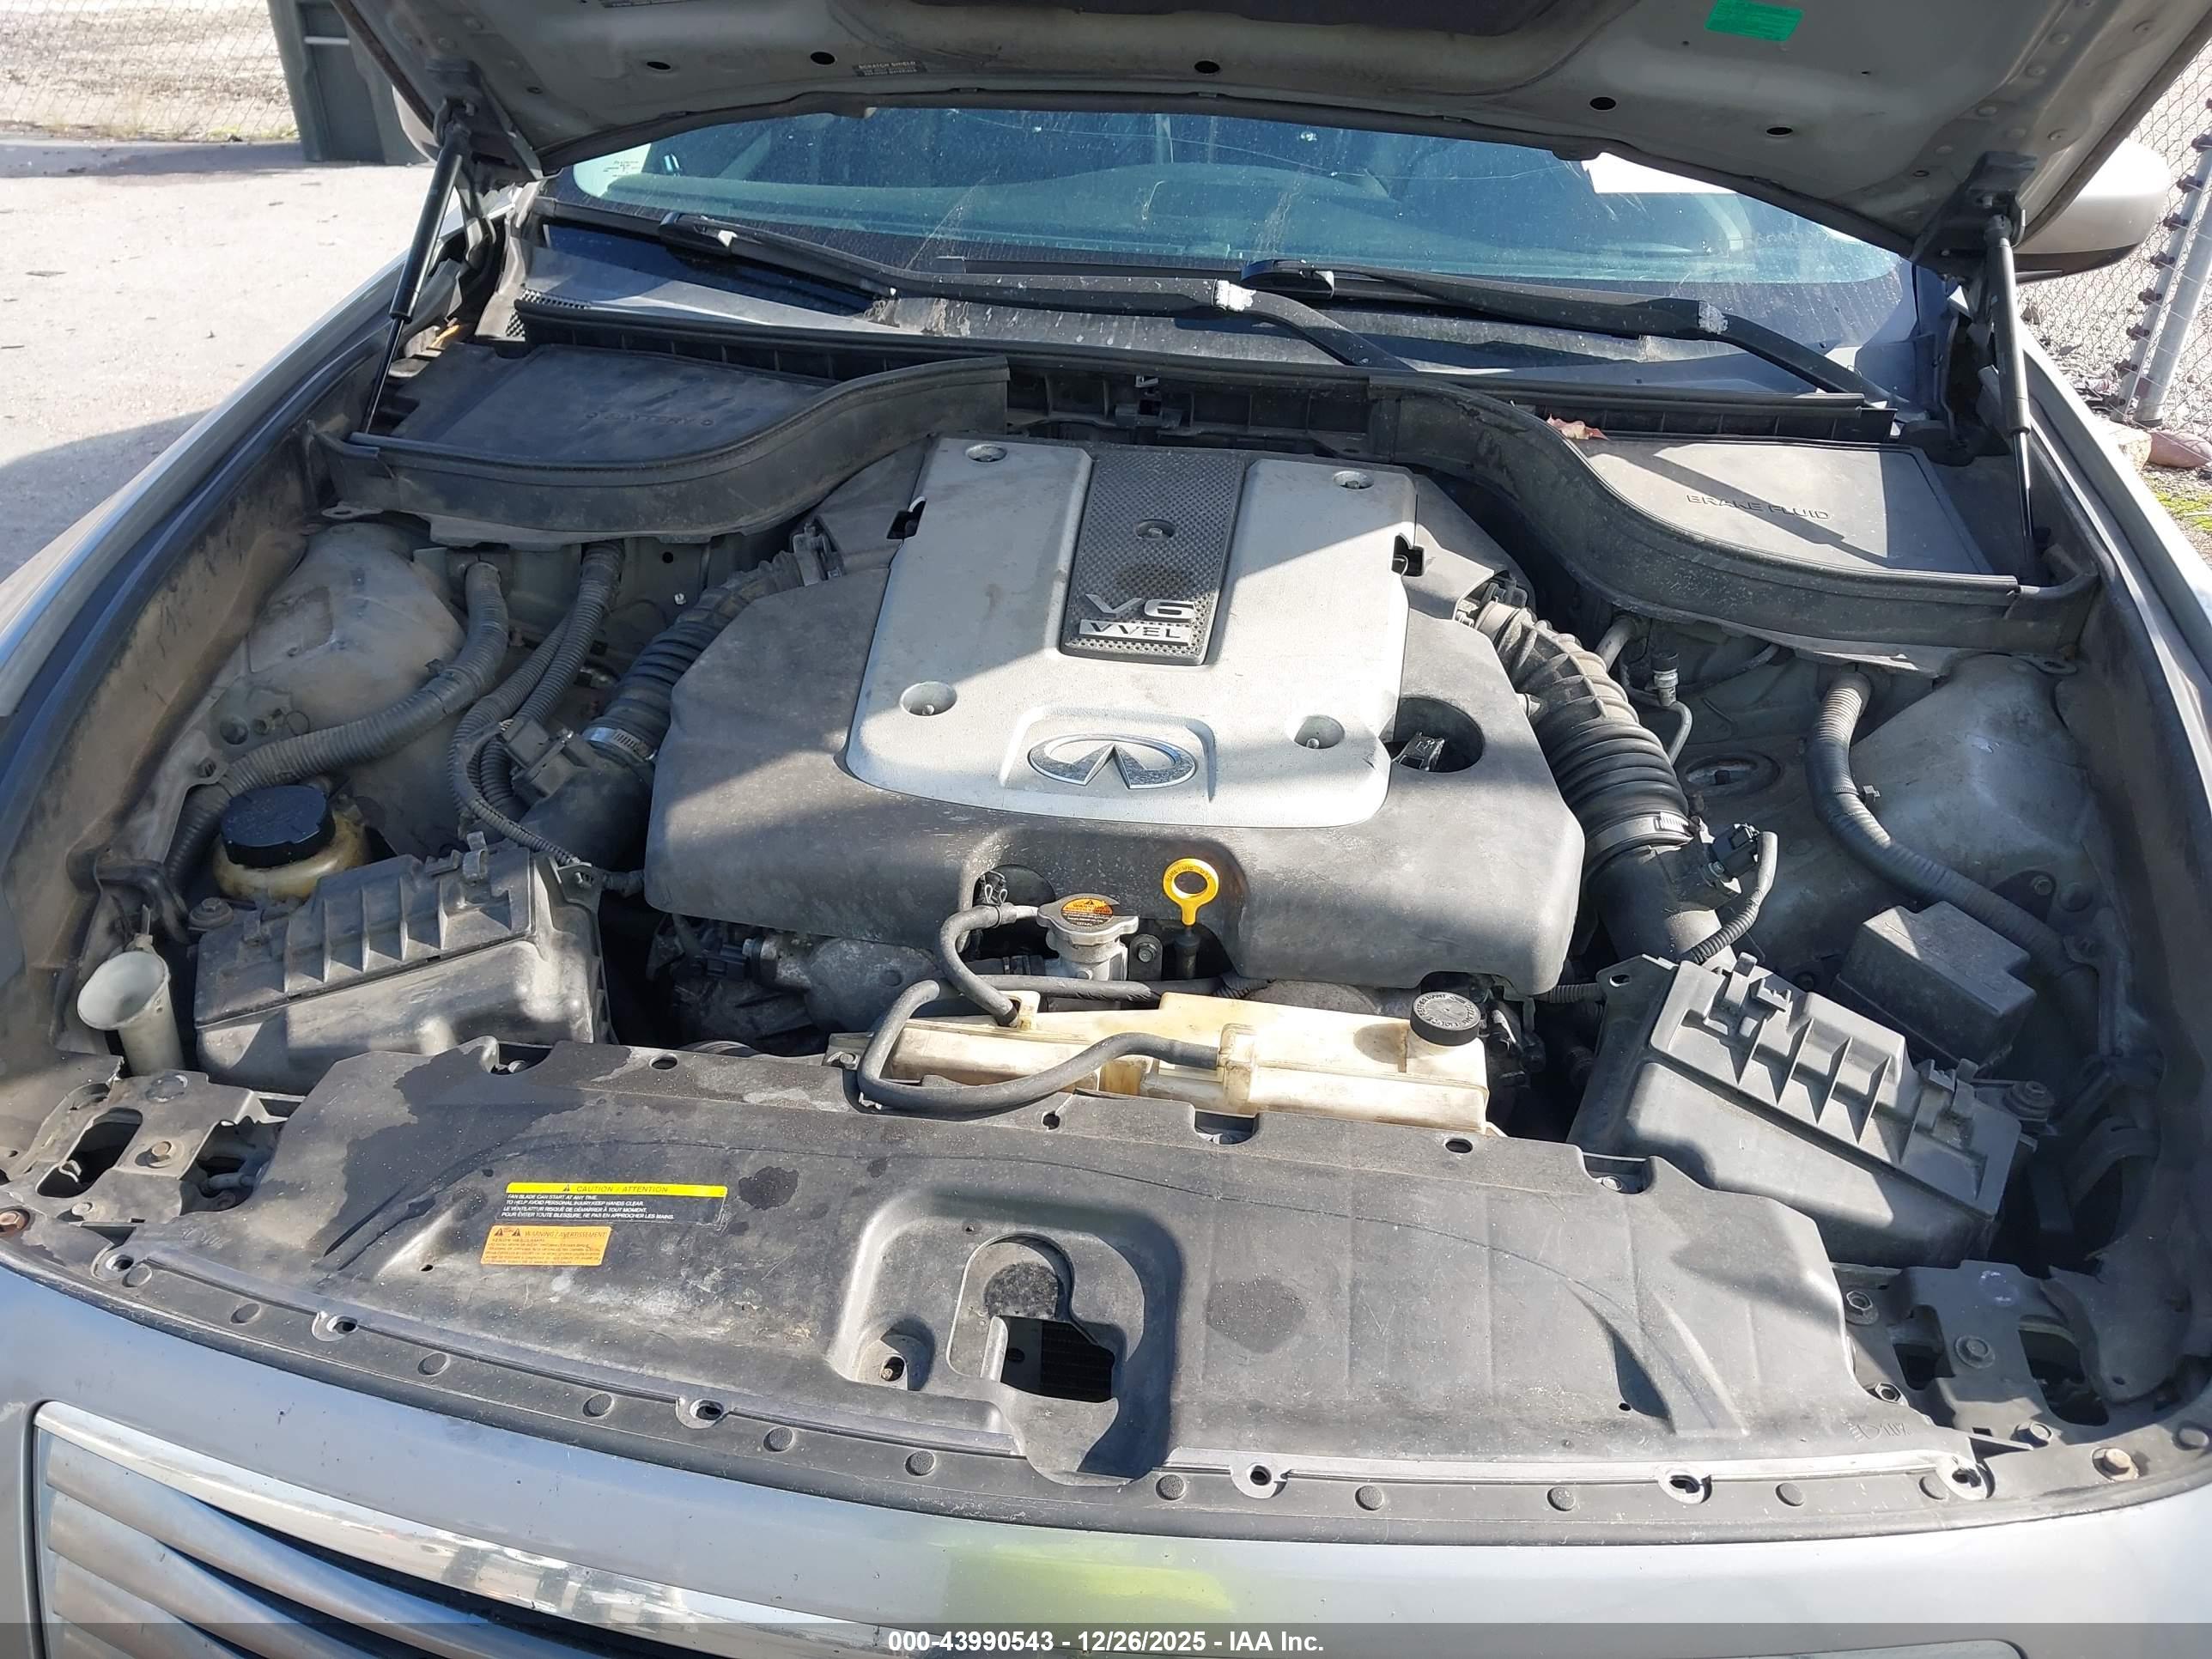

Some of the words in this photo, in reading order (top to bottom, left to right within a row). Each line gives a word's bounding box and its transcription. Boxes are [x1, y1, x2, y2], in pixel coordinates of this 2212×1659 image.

[1686, 494, 1764, 511] BRAKE
[1768, 504, 1830, 520] FLUID
[1085, 593, 1196, 619] V6
[1090, 622, 1182, 639] VVEL
